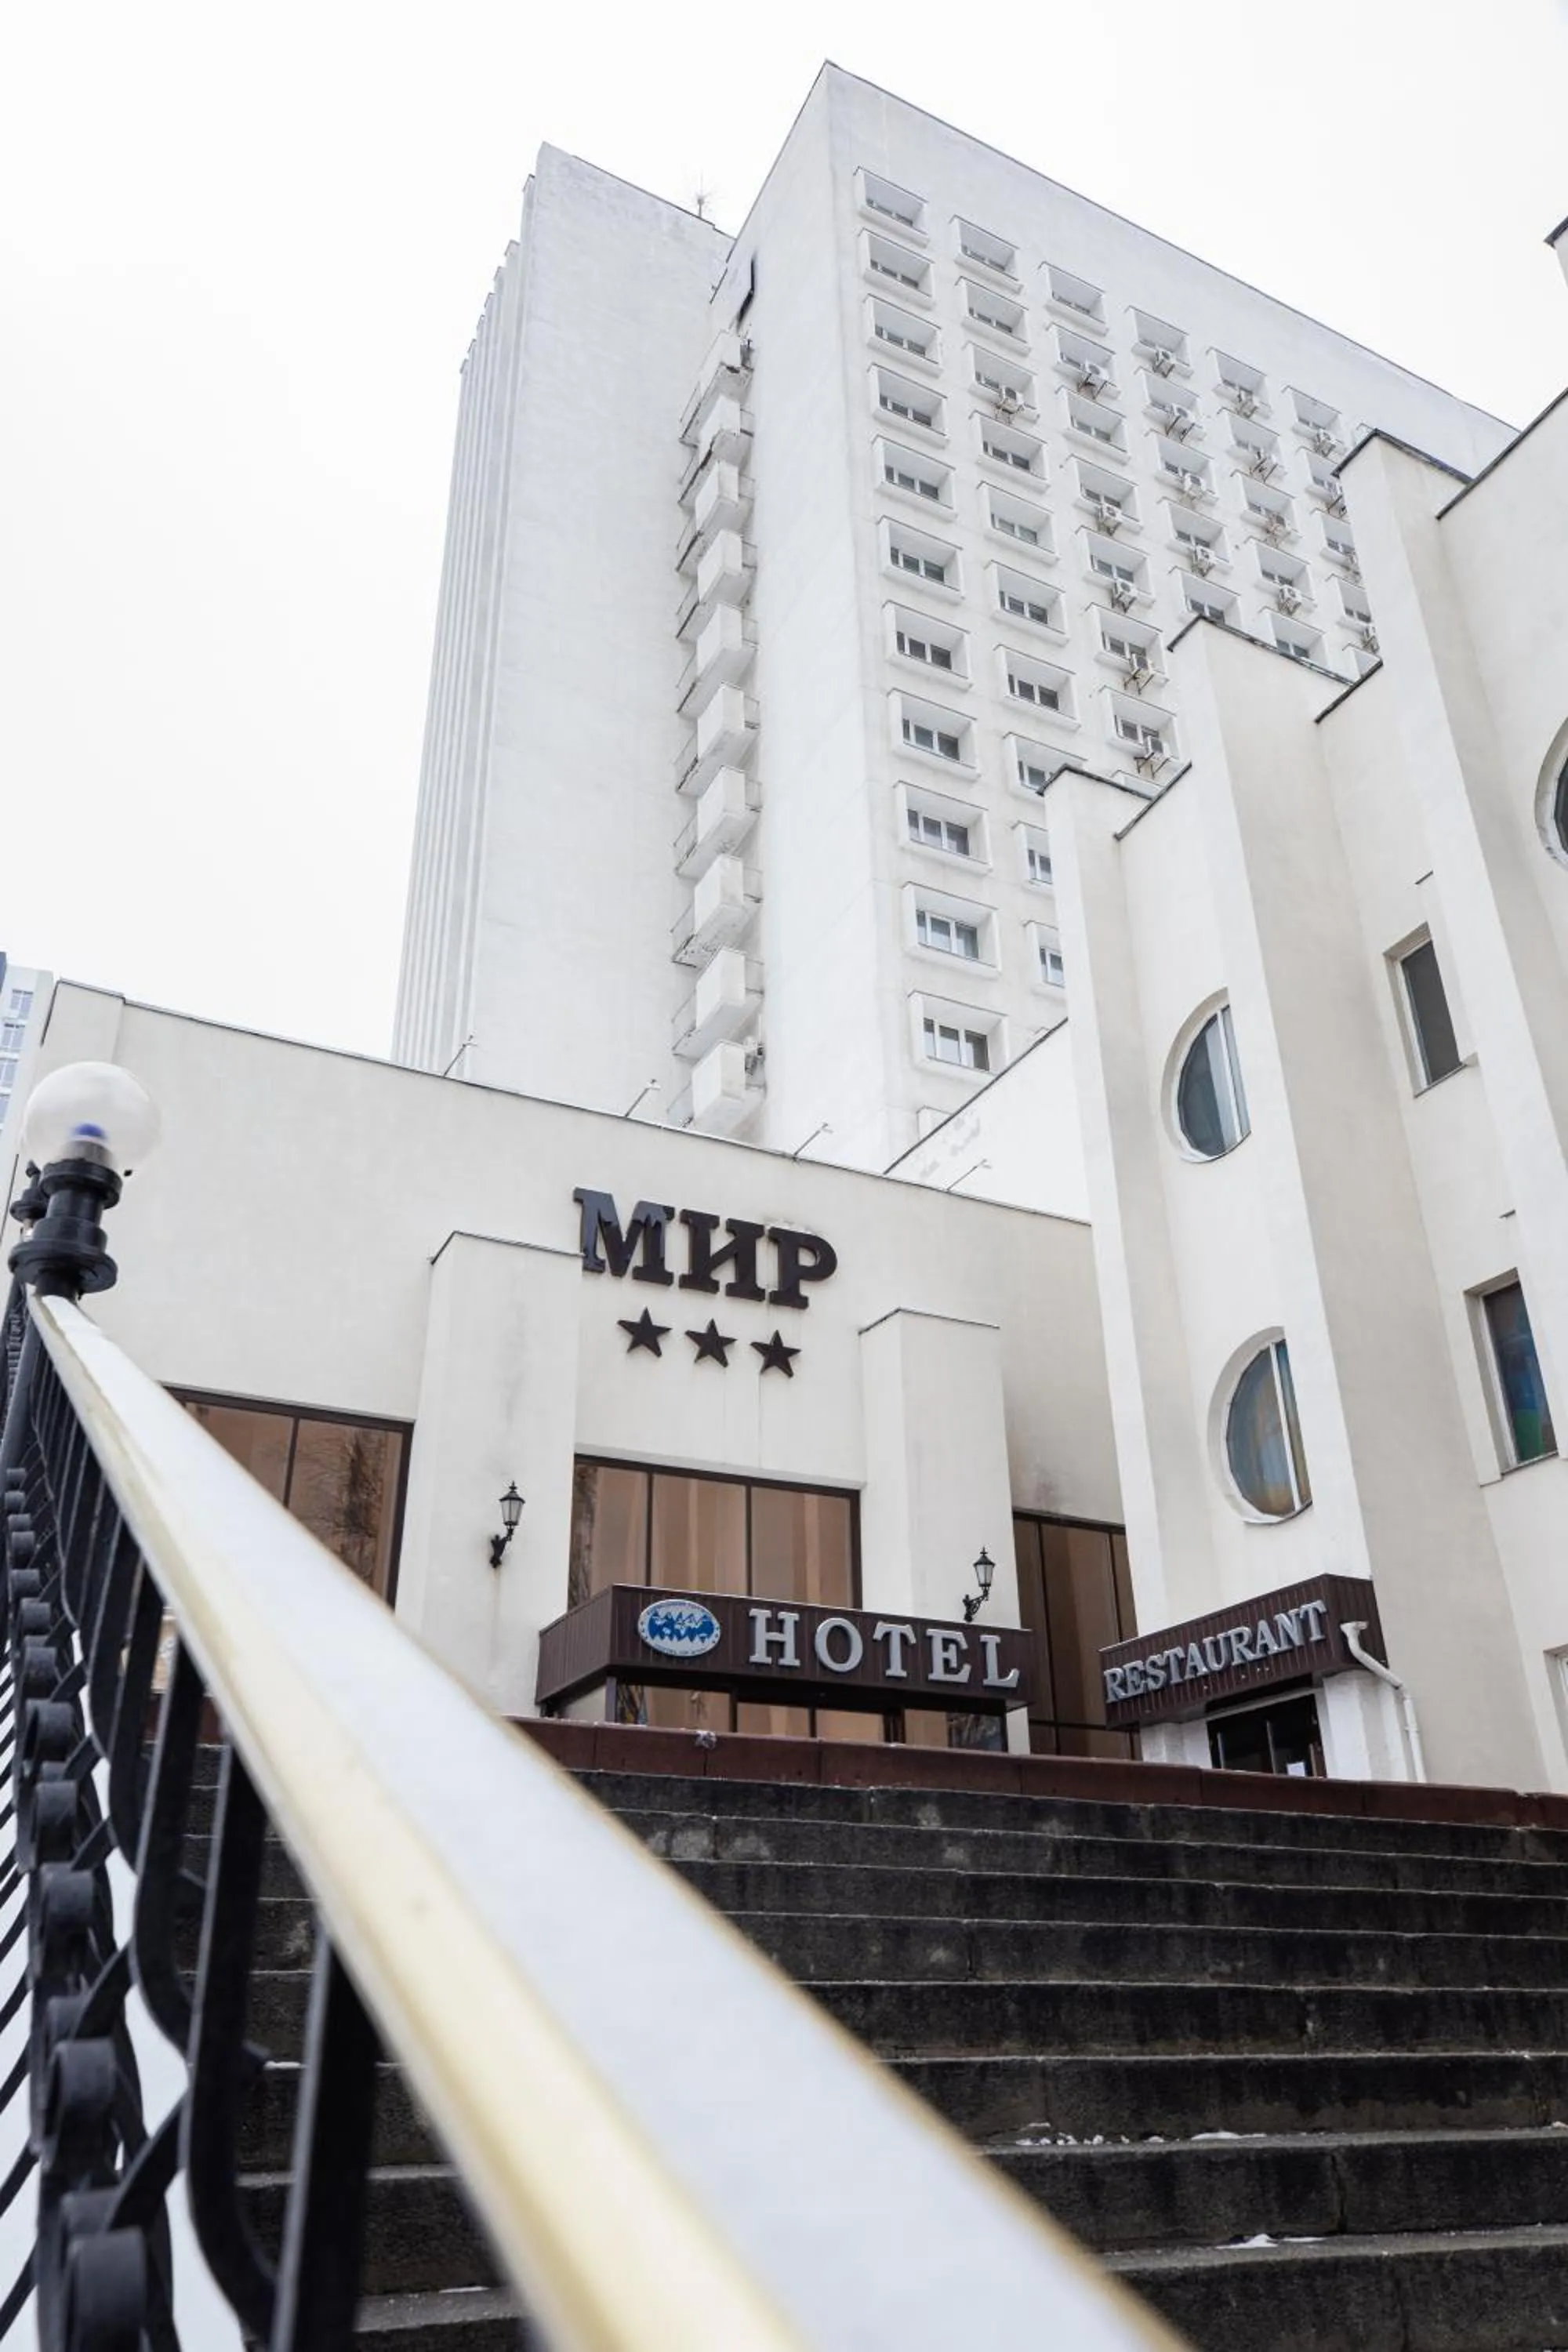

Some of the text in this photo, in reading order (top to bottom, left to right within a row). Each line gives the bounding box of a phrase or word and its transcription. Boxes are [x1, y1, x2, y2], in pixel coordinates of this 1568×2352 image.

[573, 1187, 837, 1309] МИР
[750, 1609, 1019, 1687] HOTEL
[1104, 1599, 1327, 1703] RESTAURANT
